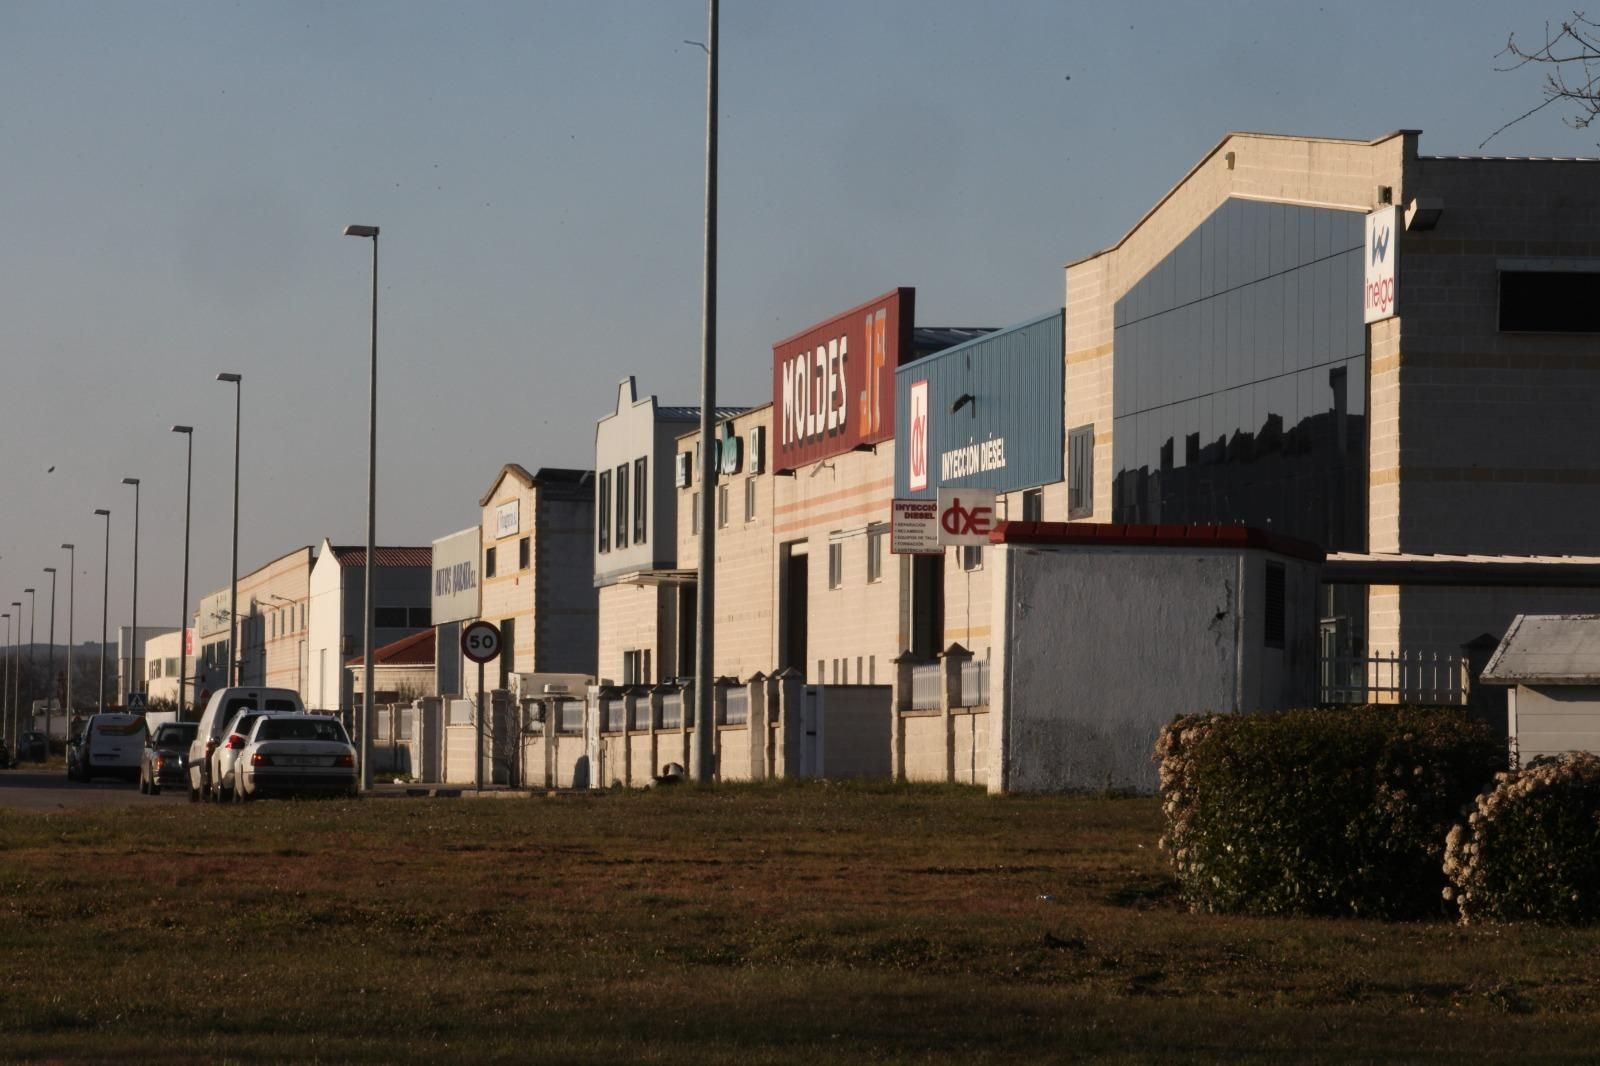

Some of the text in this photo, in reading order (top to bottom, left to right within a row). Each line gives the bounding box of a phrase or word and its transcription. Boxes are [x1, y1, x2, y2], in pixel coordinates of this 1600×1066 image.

[782, 335, 848, 446] MOLDES
[942, 432, 1006, 481] INYECCIÓN DIÉSEL
[895, 502, 937, 512] INYECCIÓ
[904, 511, 936, 520] DIESEL
[469, 635, 493, 649] 50
